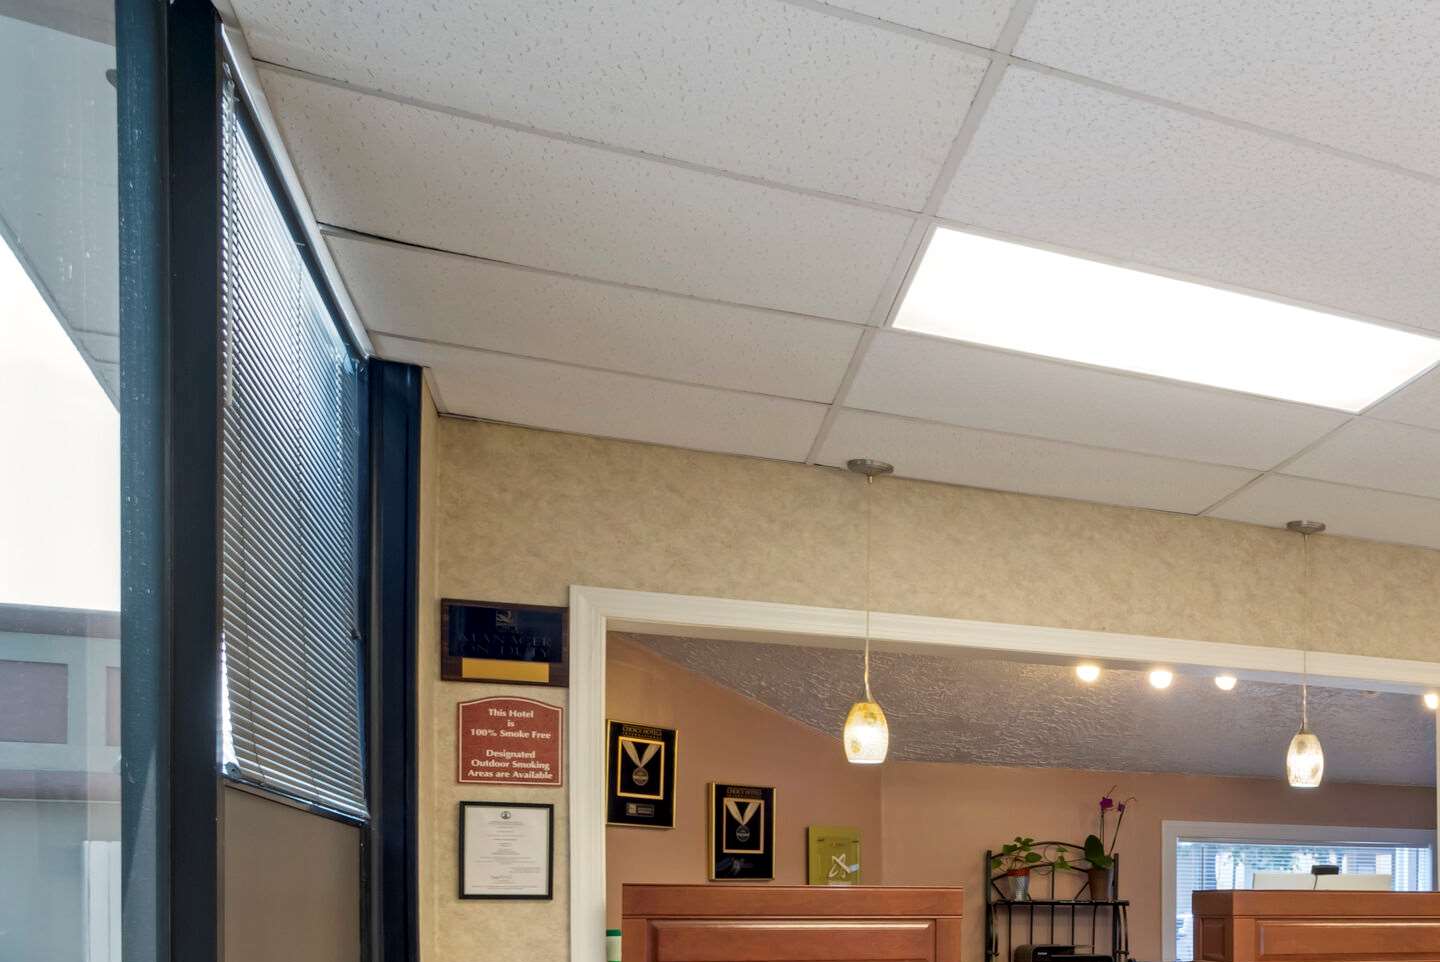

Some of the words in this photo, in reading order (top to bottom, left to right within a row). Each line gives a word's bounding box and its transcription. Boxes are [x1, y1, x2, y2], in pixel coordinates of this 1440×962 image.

[488, 708, 507, 717] This
[509, 709, 534, 718] Hotel
[507, 719, 515, 727] is
[470, 728, 497, 737] 100%
[499, 729, 530, 739] Smoke
[531, 731, 552, 739] Free
[486, 749, 536, 759] Designated
[471, 759, 510, 768] Outdoor
[512, 760, 550, 771] Smoking
[467, 769, 494, 777] Areas
[512, 771, 553, 779] Available
